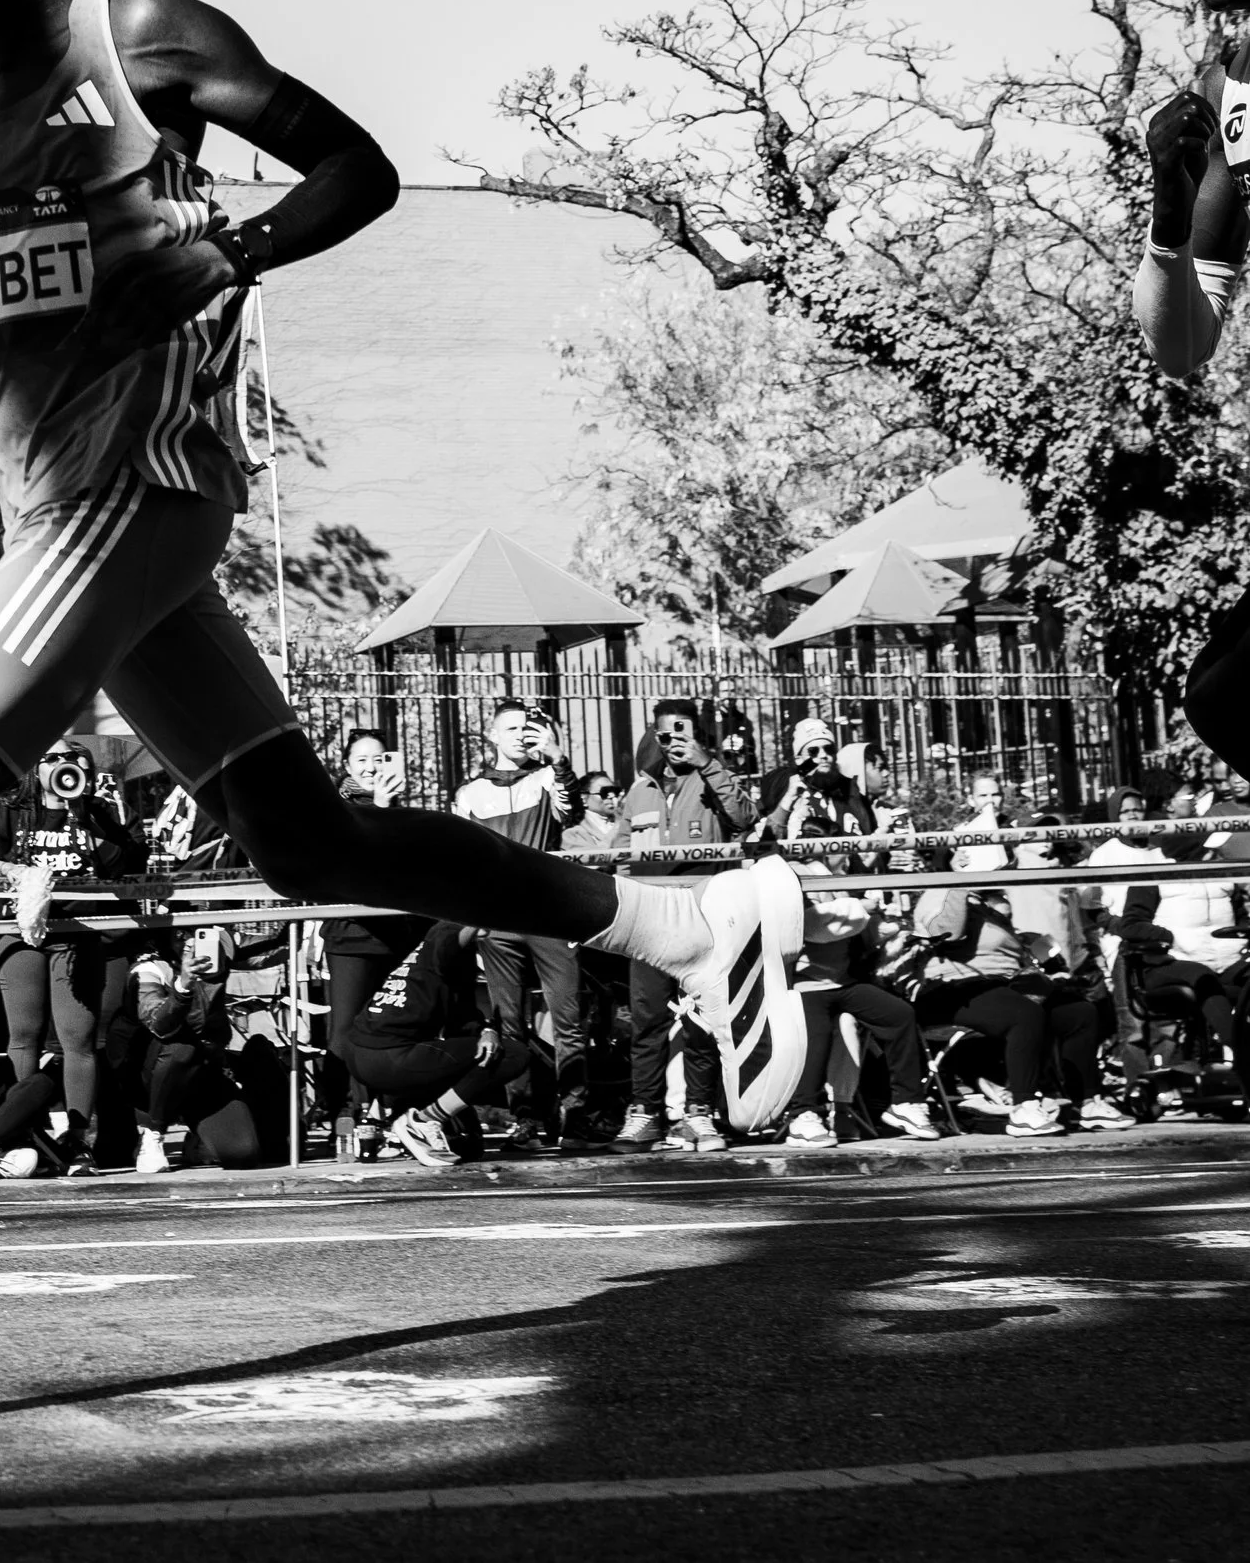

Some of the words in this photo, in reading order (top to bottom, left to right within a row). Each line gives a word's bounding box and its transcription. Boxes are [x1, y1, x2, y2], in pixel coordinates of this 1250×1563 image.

[33, 203, 68, 217] TATA
[1046, 829, 1080, 840] NEW
[1084, 826, 1123, 838] YORK
[1174, 822, 1208, 833] NEW
[782, 843, 816, 855] NEW
[820, 840, 862, 853] YORK
[915, 836, 949, 848] NEW
[952, 833, 994, 846] YORK
[30, 850, 83, 871] state
[639, 850, 678, 862] NEW
[682, 847, 725, 860] YORK
[199, 871, 240, 881] NEW
